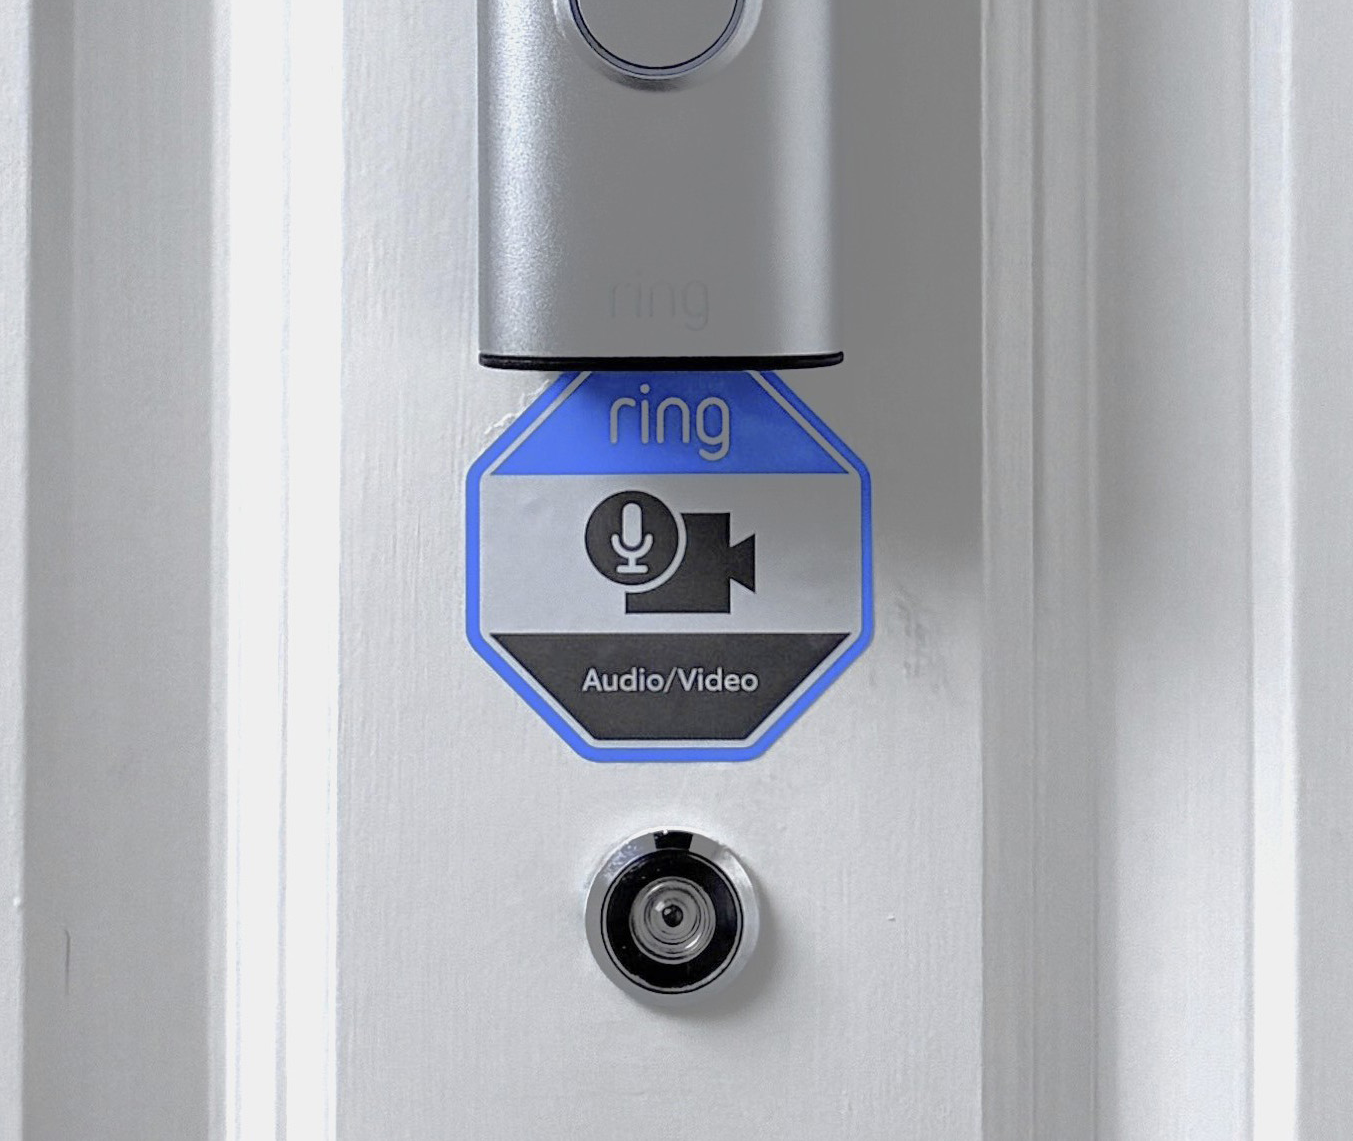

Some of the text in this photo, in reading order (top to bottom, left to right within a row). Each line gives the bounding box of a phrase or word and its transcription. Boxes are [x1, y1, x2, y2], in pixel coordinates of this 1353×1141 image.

[610, 269, 709, 332] ring
[610, 383, 730, 461] ring
[582, 667, 759, 693] Audio/Video
